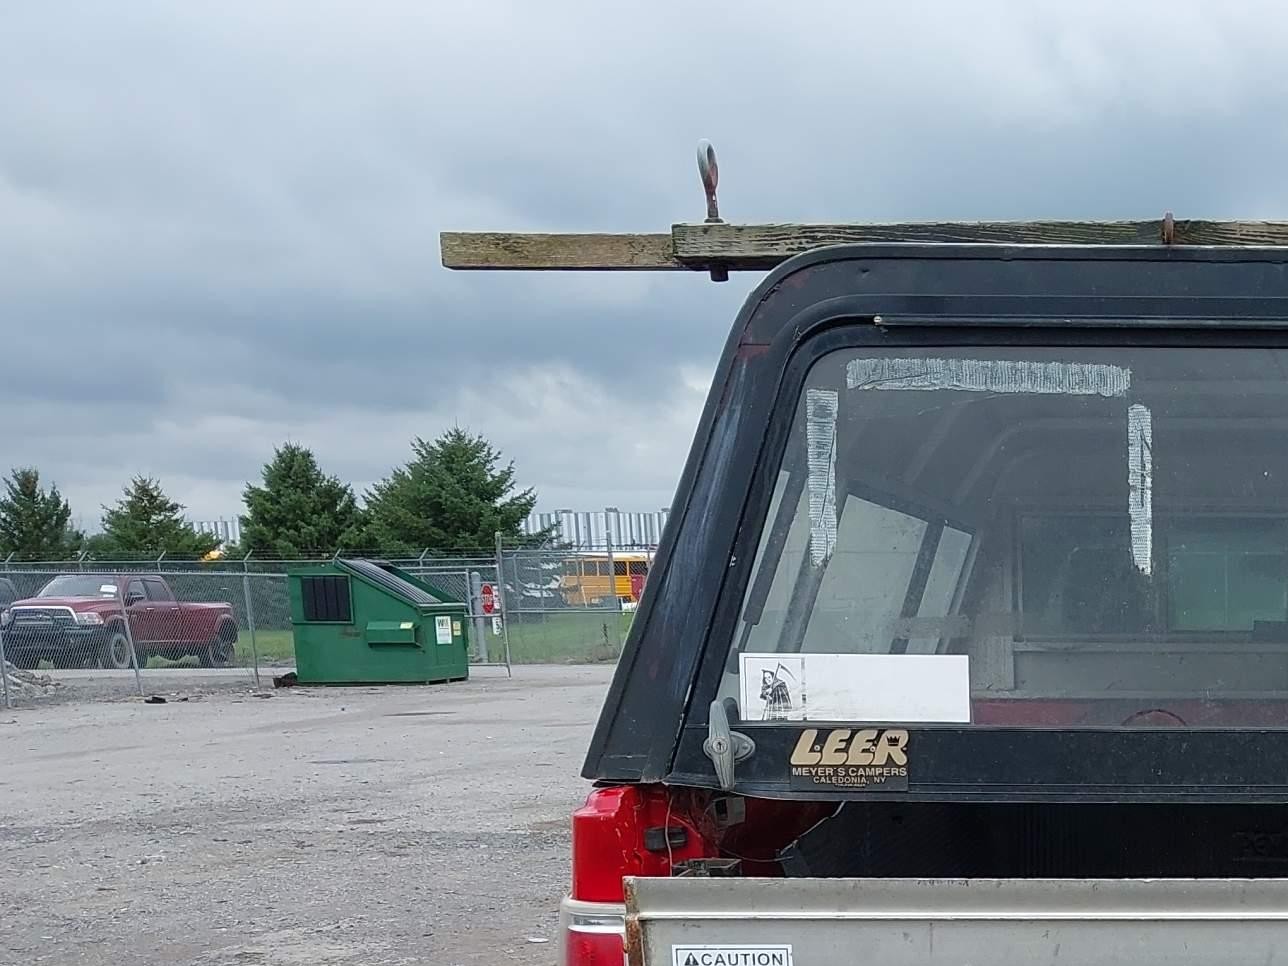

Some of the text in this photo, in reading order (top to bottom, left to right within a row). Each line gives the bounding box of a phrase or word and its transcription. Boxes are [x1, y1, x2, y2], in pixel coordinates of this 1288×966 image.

[790, 729, 909, 766] LEER
[792, 767, 907, 776] MEYER'S CAMPERS
[813, 776, 886, 785] CALEDONIA, NY
[701, 953, 783, 966] CAUTION
